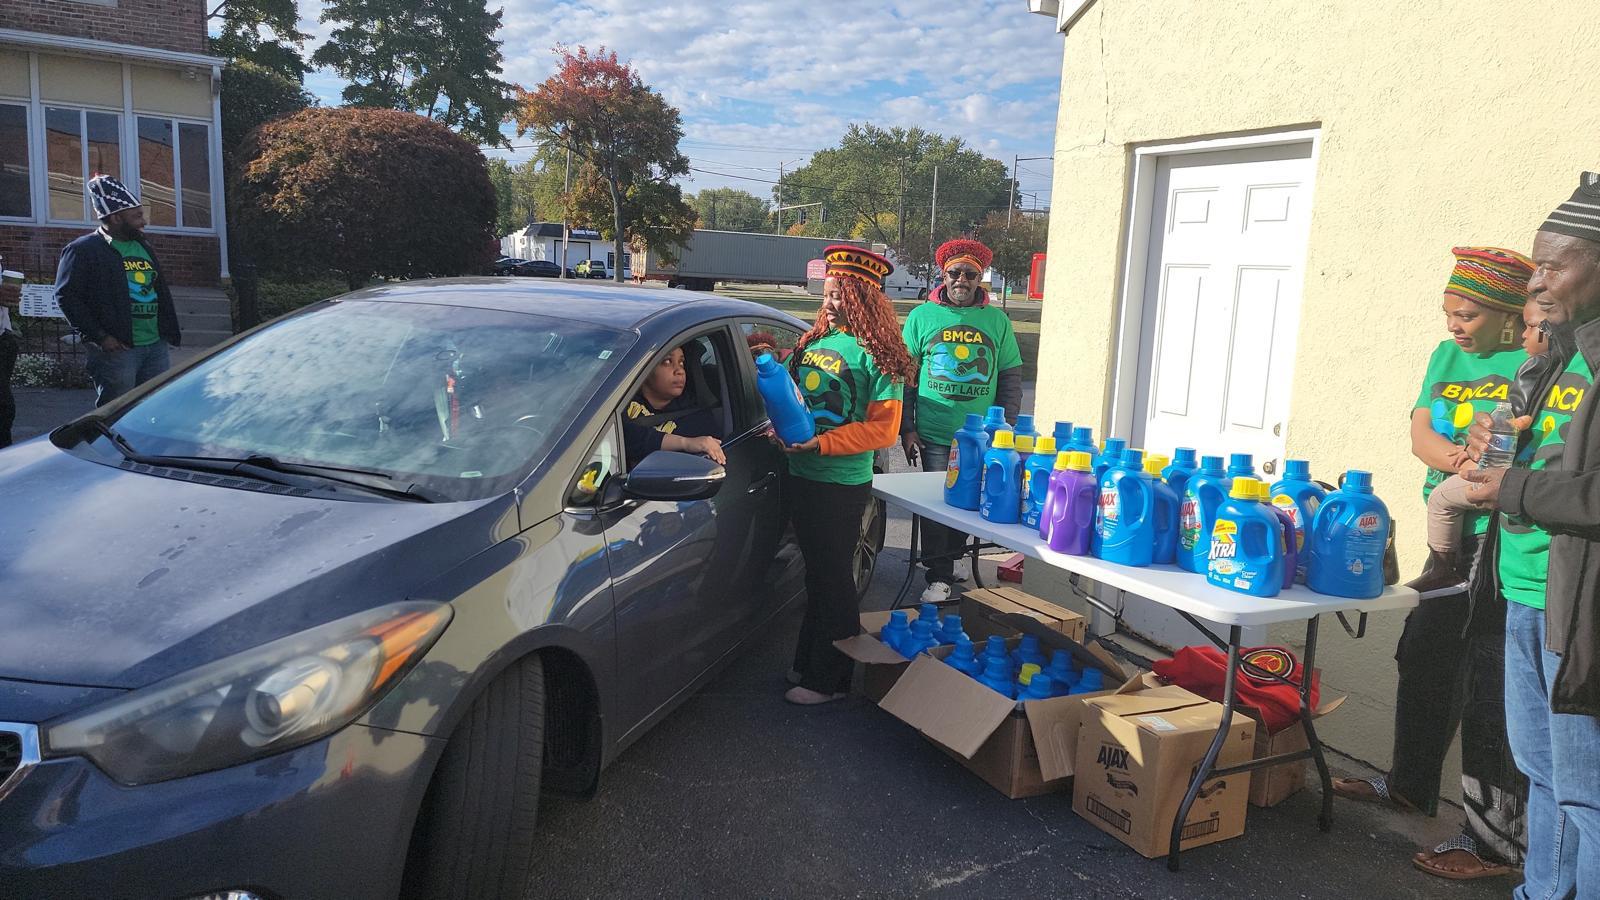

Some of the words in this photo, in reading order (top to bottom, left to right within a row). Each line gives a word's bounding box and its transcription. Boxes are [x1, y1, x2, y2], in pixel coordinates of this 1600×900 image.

[942, 329, 983, 344] BMCA
[801, 351, 842, 374] BMCA
[927, 380, 958, 394] GREAT
[959, 383, 990, 396] LAKES
[1359, 516, 1378, 528] AJAX
[1208, 541, 1237, 560] XTRA
[1097, 745, 1130, 770] AJAX
